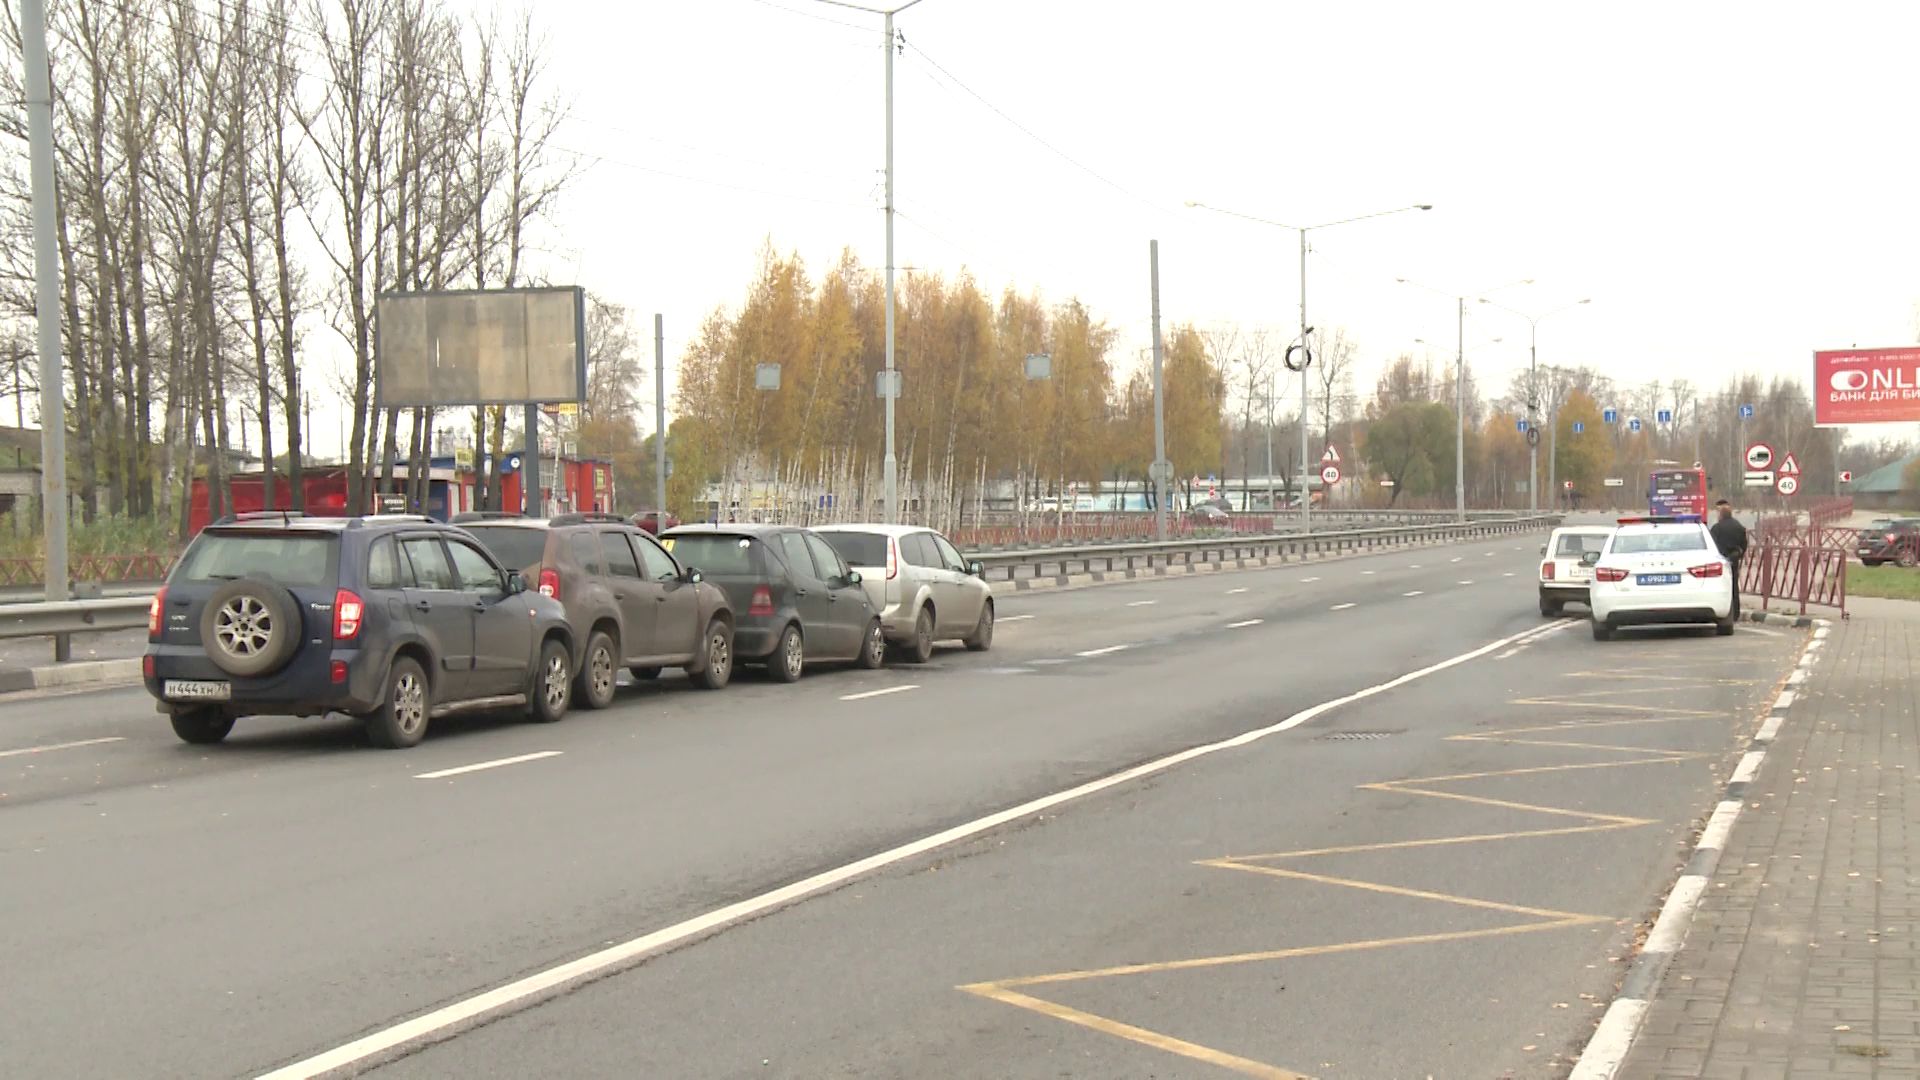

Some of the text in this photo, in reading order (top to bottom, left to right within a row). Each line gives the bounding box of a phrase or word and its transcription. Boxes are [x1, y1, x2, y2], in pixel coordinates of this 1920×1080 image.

[1830, 391, 1866, 402] БАНК
[1869, 390, 1898, 402] ДЛЯ
[1781, 481, 1794, 490] 40
